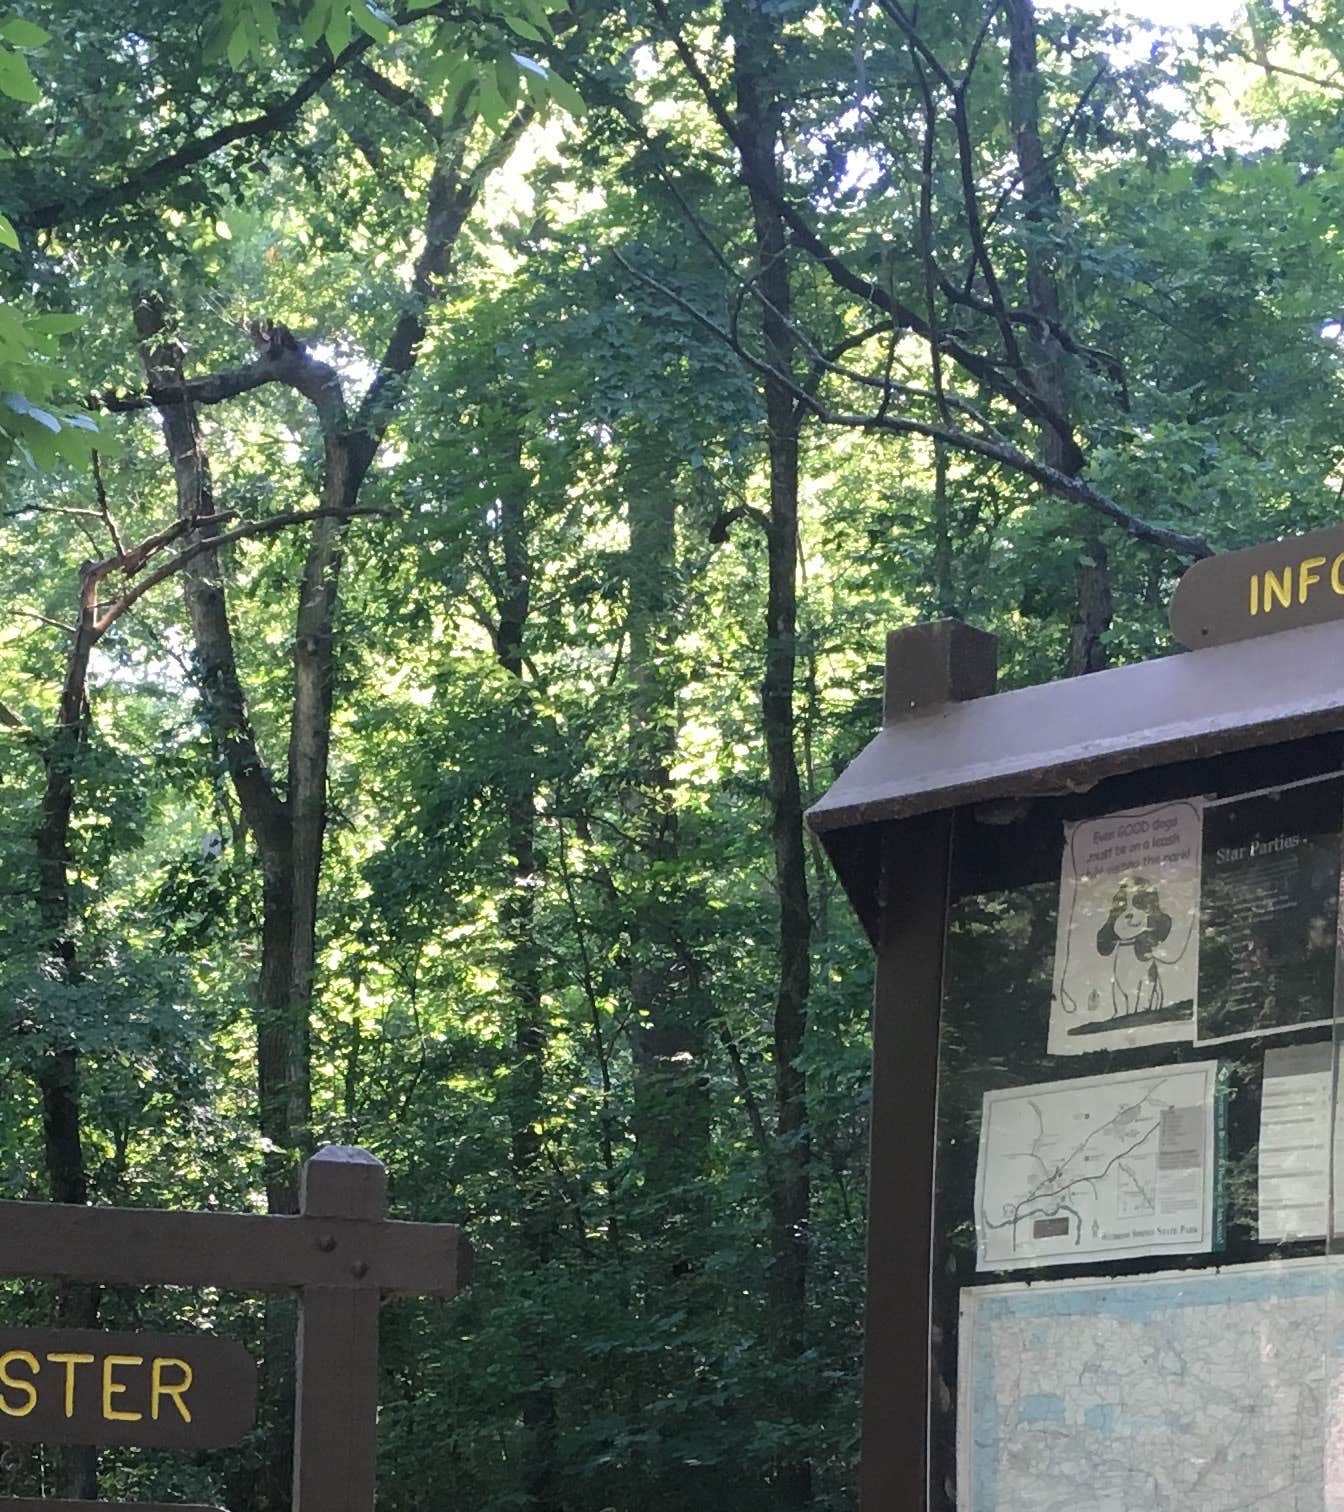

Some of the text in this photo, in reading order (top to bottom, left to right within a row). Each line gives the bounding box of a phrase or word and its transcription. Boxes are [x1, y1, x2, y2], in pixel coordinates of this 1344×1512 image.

[1118, 820, 1150, 838] GOOD
[1215, 833, 1300, 865] Star Parties
